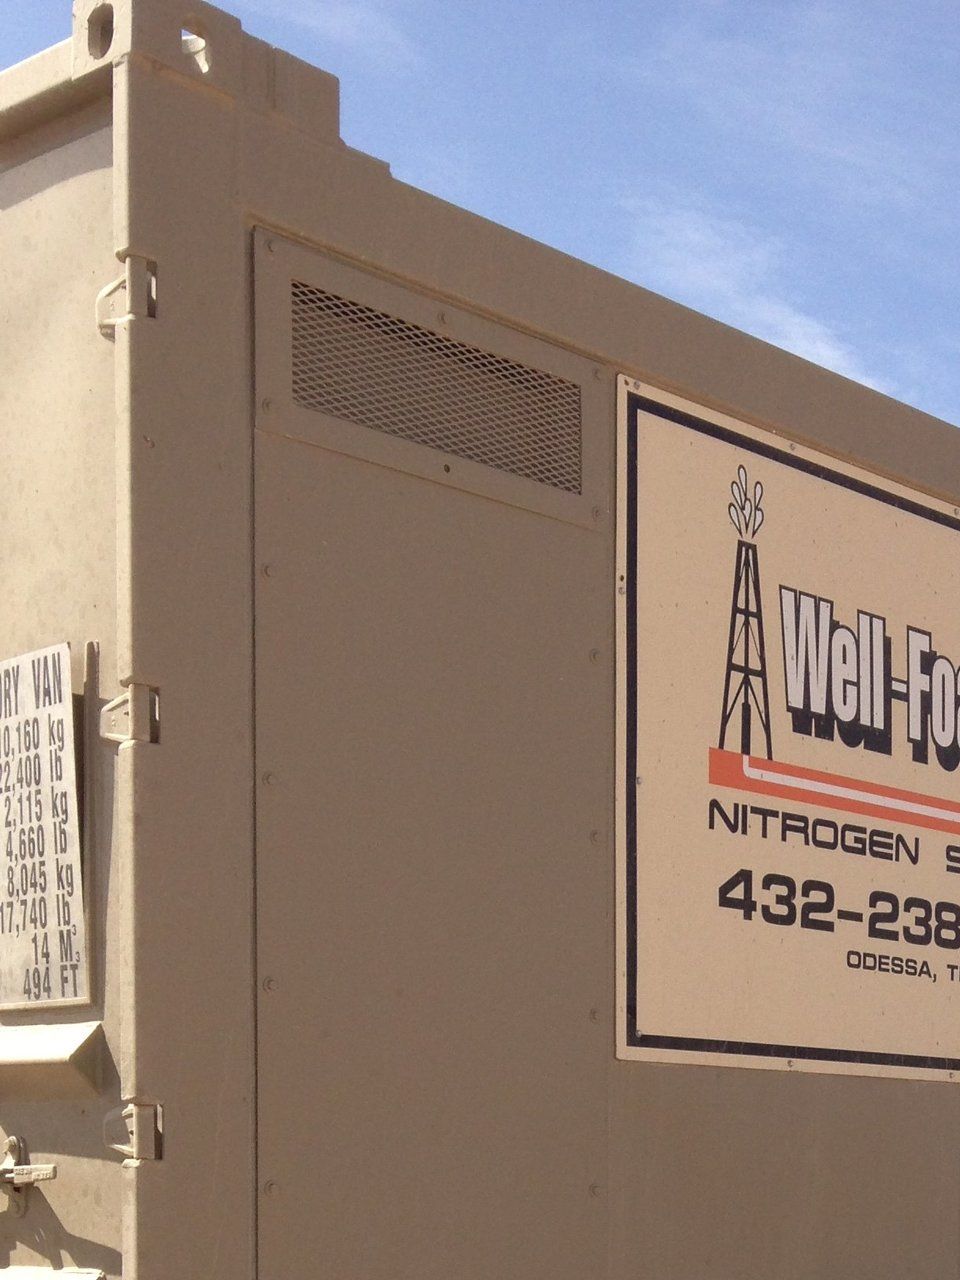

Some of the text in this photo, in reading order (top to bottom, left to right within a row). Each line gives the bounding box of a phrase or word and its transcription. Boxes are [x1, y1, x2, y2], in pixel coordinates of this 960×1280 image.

[0, 652, 62, 719] RY VAN
[0, 713, 64, 761] 0,160 kg
[49, 748, 62, 782] lb
[5, 786, 68, 832] 2,115 kg
[6, 821, 67, 867] 4,660 lb
[708, 798, 920, 865] NITROGEN
[7, 858, 73, 902] 8,045 kg
[56, 894, 70, 927] lb
[31, 932, 50, 965] 14
[846, 950, 937, 983] ODESSA,
[23, 966, 51, 1000] 494
